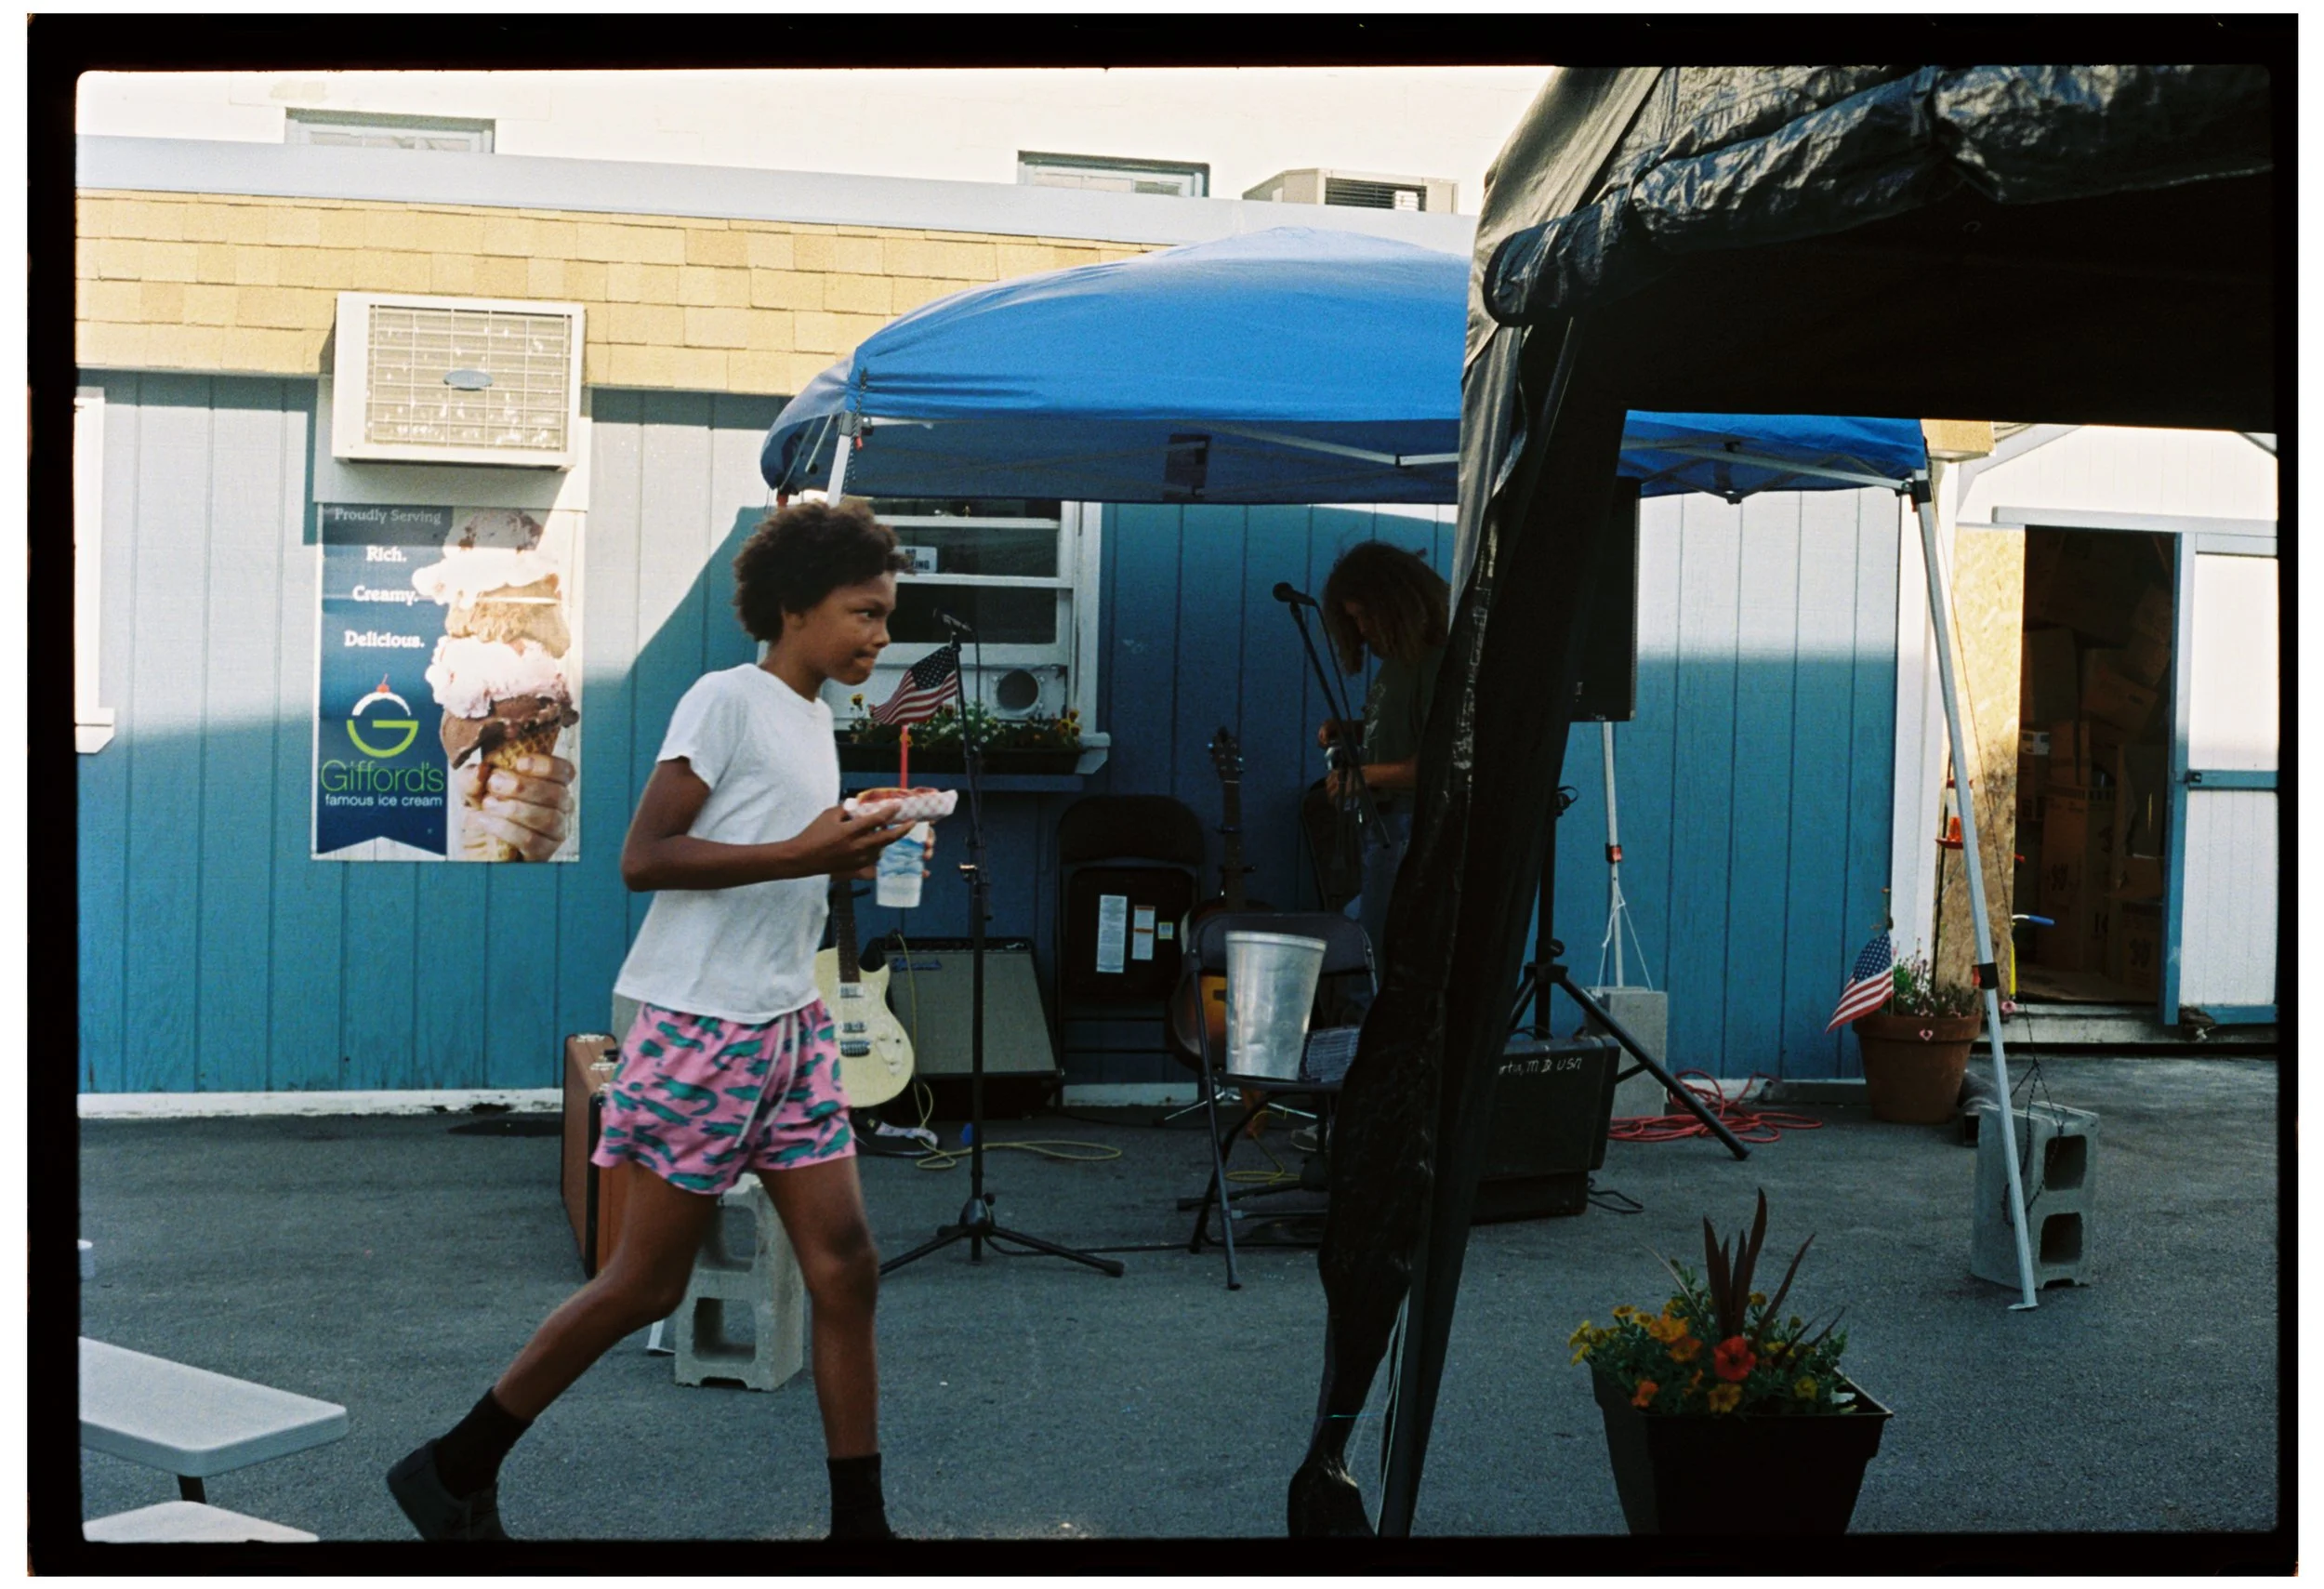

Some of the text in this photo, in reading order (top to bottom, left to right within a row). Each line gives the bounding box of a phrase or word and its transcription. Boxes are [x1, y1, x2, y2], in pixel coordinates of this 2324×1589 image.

[335, 509, 442, 525] Proudly Serving
[366, 545, 407, 563] Rich.
[352, 585, 418, 606] Creamy.
[344, 629, 426, 648] Delicious.
[321, 760, 444, 792] Gifford's
[325, 794, 442, 807] famous ice cream
